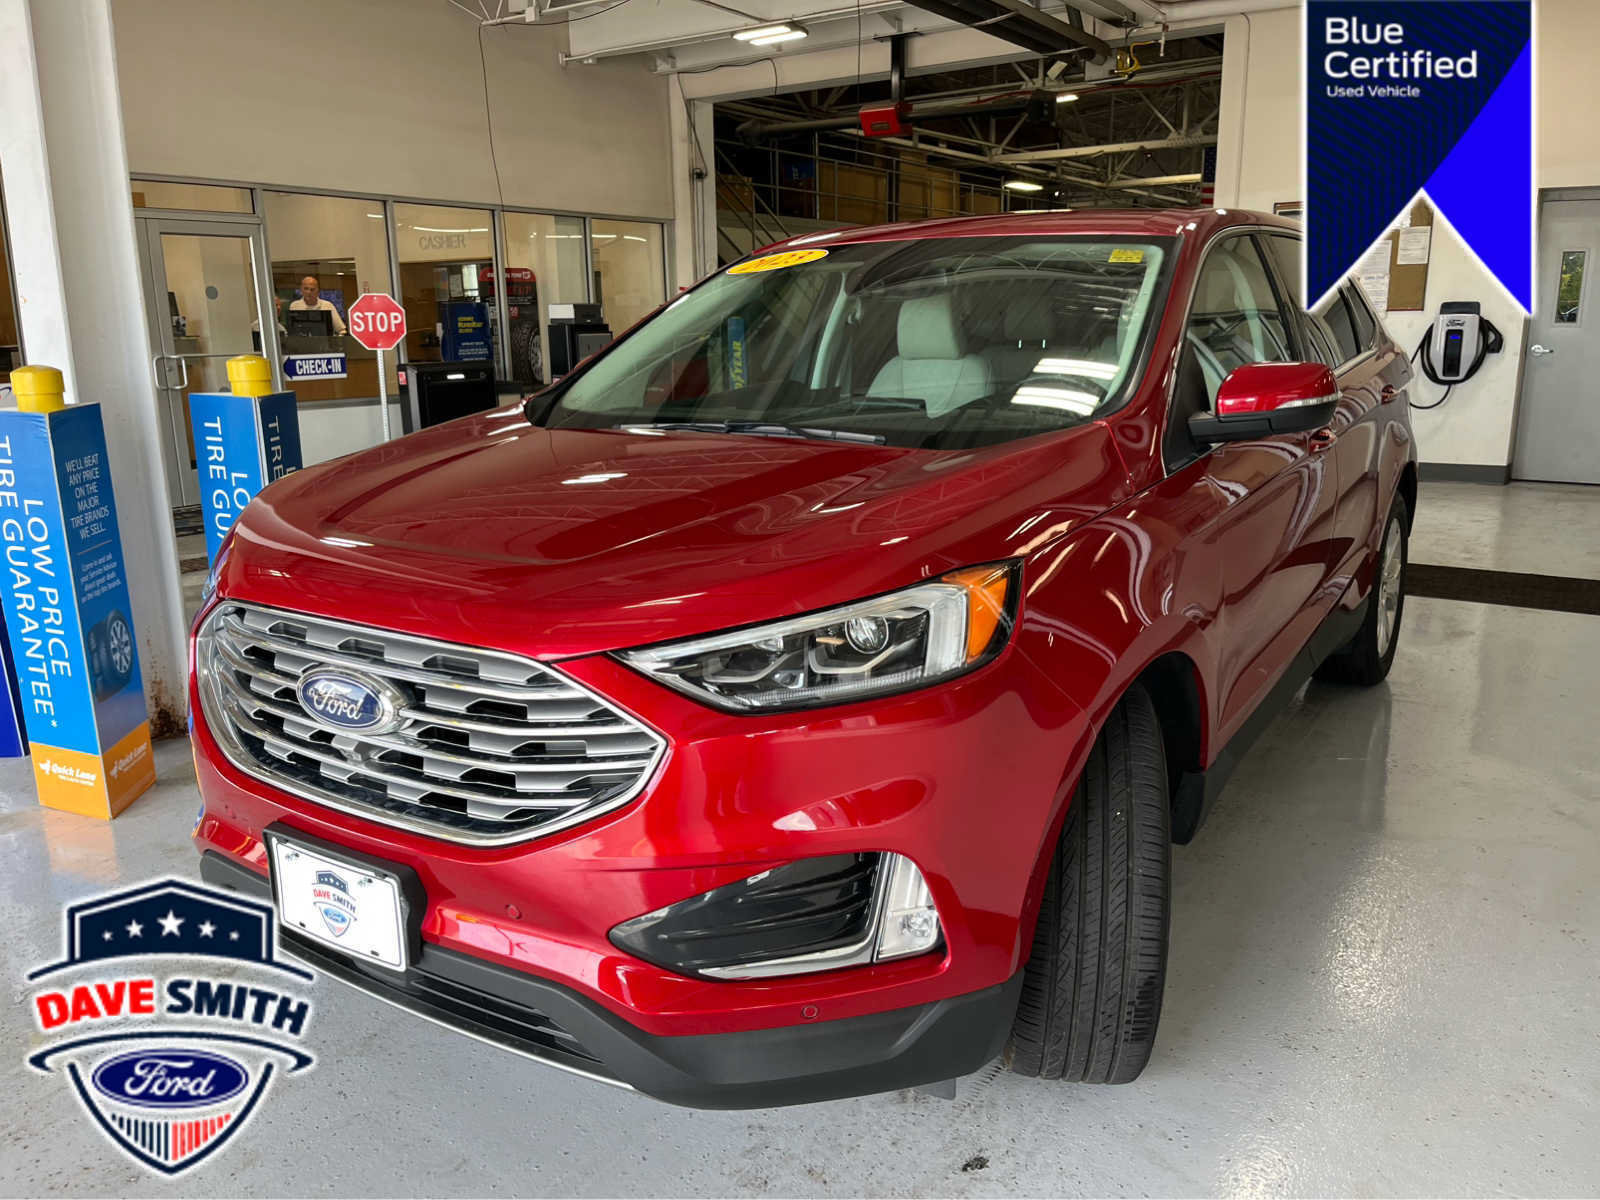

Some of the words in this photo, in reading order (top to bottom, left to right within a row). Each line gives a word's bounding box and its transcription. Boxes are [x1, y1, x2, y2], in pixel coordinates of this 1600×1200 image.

[418, 235, 466, 250] CASHIER
[353, 312, 402, 332] STOP
[296, 359, 341, 375] CHECK-IN
[204, 416, 228, 480] TIRE
[268, 416, 284, 480] TIRE
[84, 453, 99, 468] BEAT
[0, 435, 19, 508] TIRE
[69, 472, 82, 487] ANY
[82, 467, 100, 482] PRICE
[75, 486, 86, 499] ON
[86, 481, 98, 494] THE
[77, 495, 99, 513] MAJOR
[70, 514, 85, 529] TIRE
[84, 504, 110, 524] BRANDS
[24, 499, 55, 577] LOW
[80, 526, 90, 540] WE
[38, 586, 72, 677] PRICE
[307, 681, 364, 720] Ford
[51, 762, 75, 777] Quick
[76, 766, 97, 781] Lane
[312, 888, 331, 900] DAVE
[332, 893, 356, 913] SMITH
